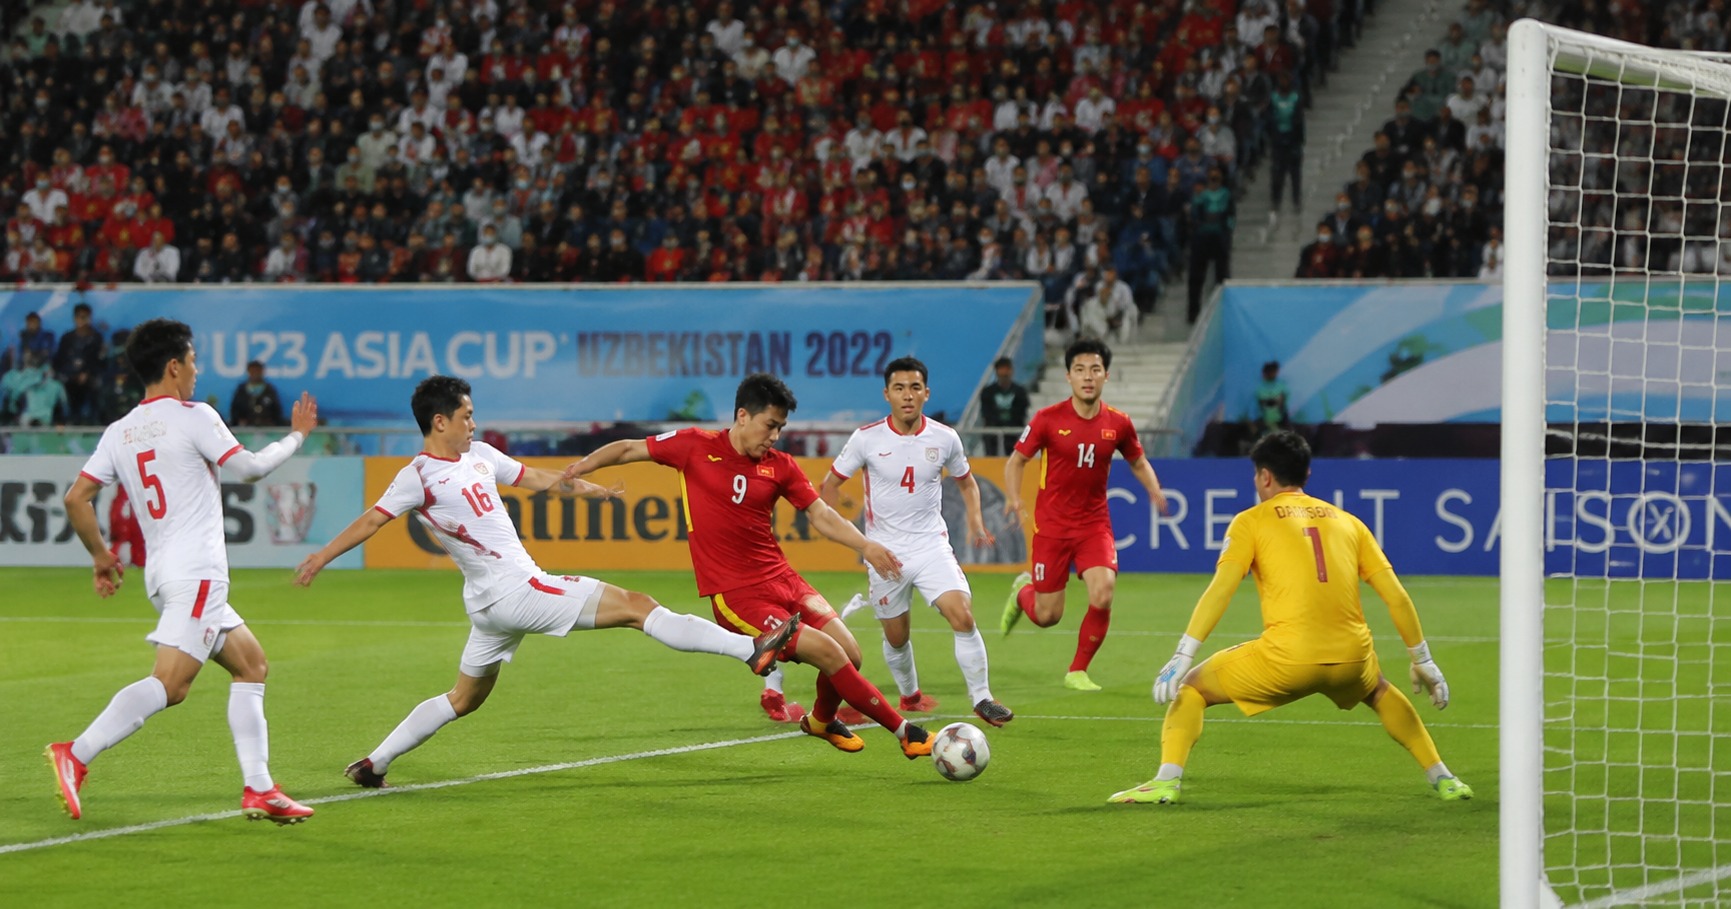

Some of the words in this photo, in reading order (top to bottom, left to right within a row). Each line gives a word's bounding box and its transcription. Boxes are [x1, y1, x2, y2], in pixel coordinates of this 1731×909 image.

[212, 331, 308, 378] U23
[315, 331, 438, 379] ASIA
[446, 331, 557, 379] CUP
[577, 331, 791, 377] UZBEKISTAN
[806, 331, 893, 377] 2022
[1077, 443, 1095, 468] 14
[136, 449, 167, 520] 5
[731, 474, 747, 504] 9
[901, 466, 915, 493] 4
[462, 482, 495, 517] 16
[1302, 527, 1328, 583] 1
